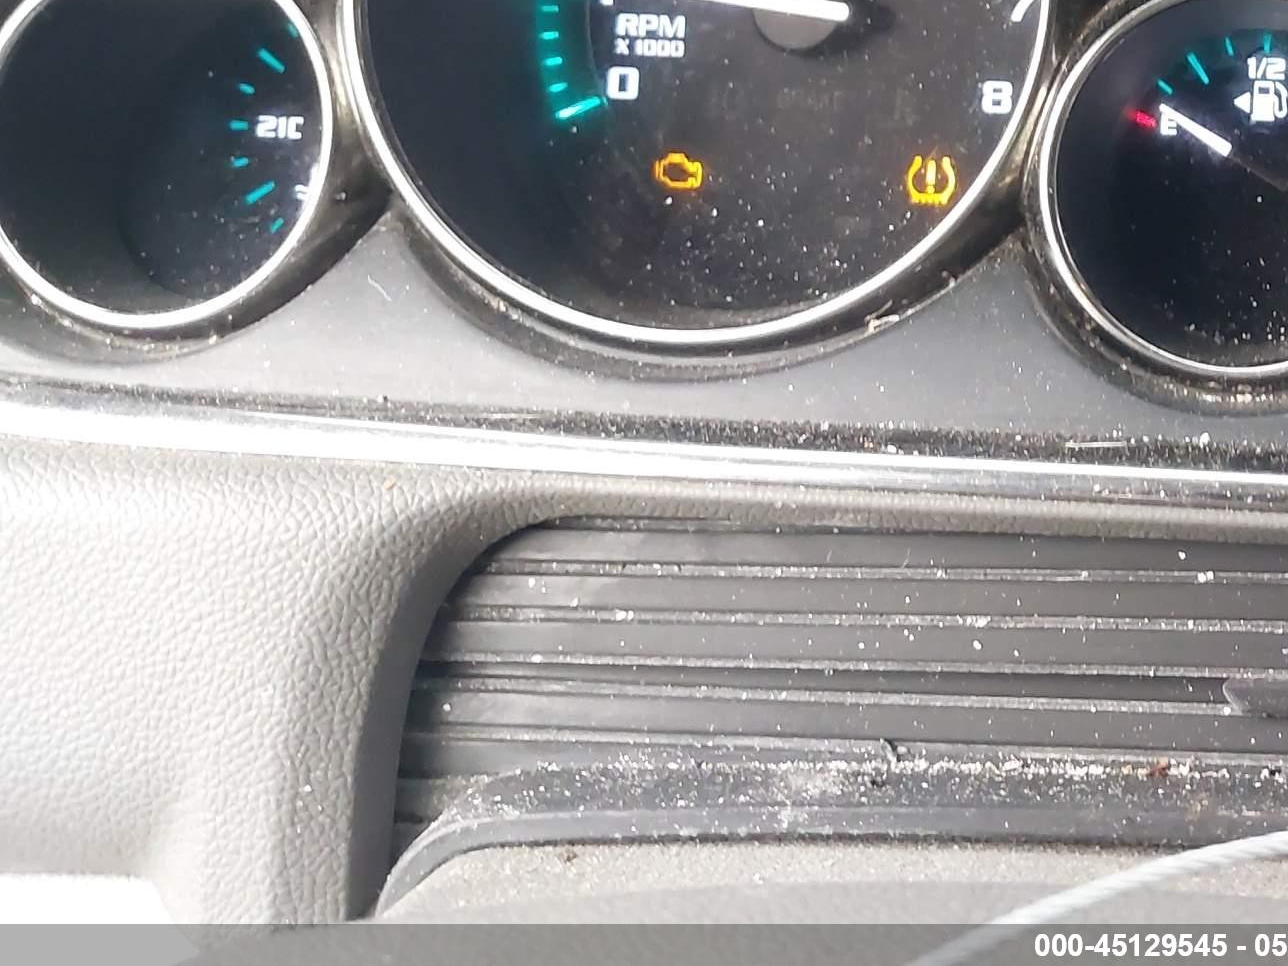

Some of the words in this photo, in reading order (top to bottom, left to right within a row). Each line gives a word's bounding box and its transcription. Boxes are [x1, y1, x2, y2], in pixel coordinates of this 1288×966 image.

[615, 14, 686, 39] RPM
[634, 39, 685, 57] 1000
[1247, 56, 1287, 83] 1/2
[606, 68, 640, 101] 0
[981, 82, 1014, 114] 8
[1160, 116, 1178, 136] E
